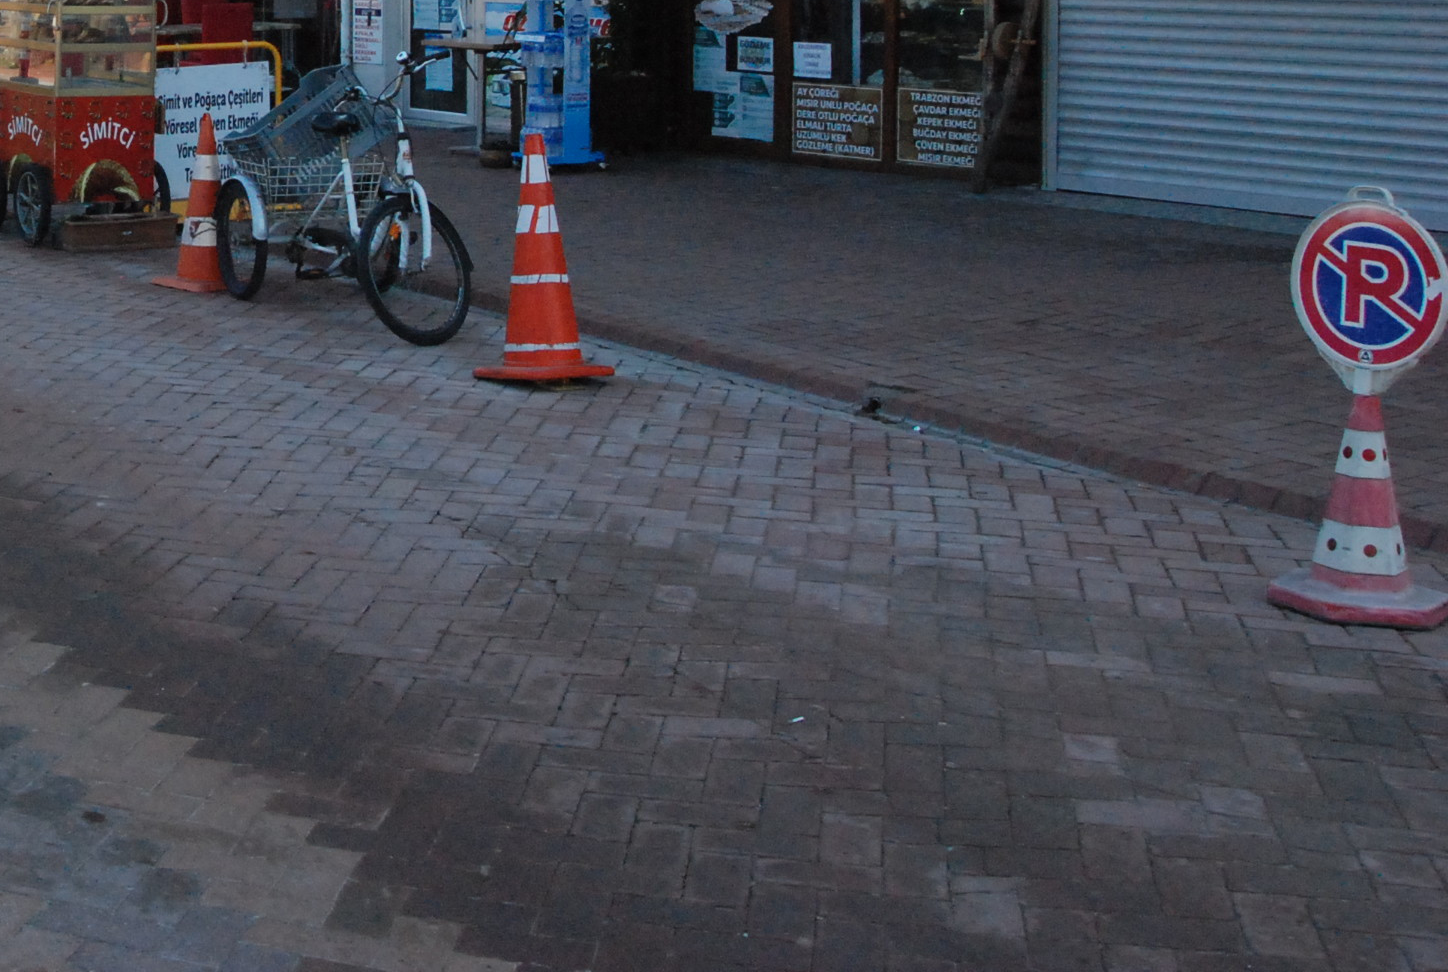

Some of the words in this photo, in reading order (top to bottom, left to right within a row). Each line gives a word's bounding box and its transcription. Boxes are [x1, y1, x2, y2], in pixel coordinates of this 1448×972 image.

[182, 97, 192, 109] ve
[194, 91, 226, 111] Poğaça
[228, 88, 264, 110] Çeşitleri
[911, 92, 950, 103] TRABZON
[952, 93, 982, 106] EKMEĞ
[80, 117, 136, 149] SİMİTCİ
[165, 117, 197, 135] Yöresel
